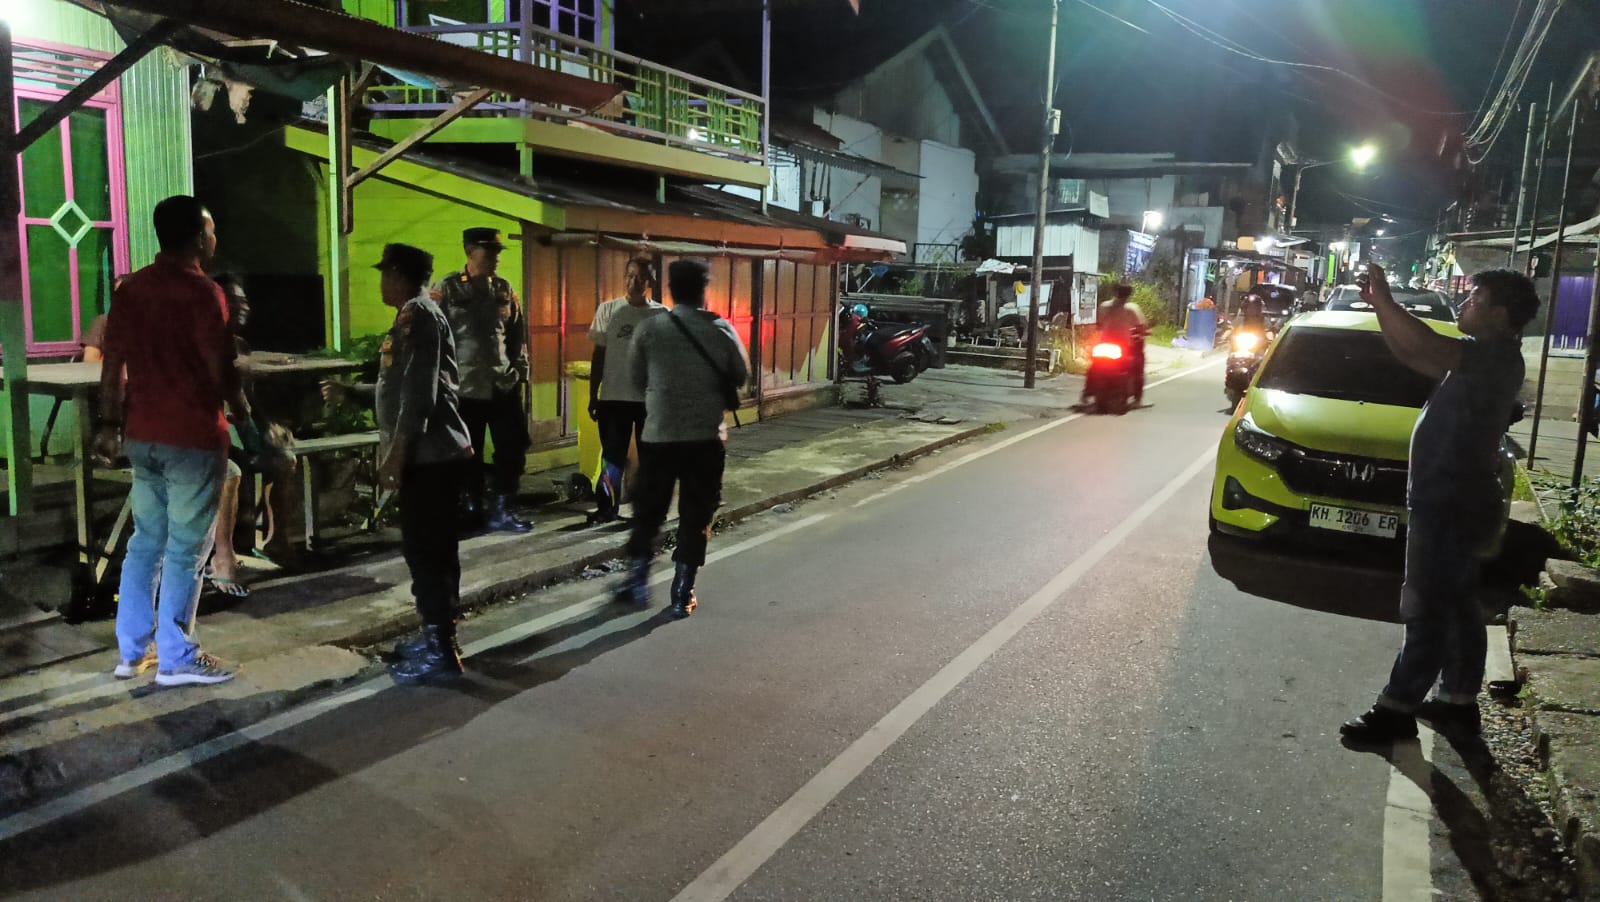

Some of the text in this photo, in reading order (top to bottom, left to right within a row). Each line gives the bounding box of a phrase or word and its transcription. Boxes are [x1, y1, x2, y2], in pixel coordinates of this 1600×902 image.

[1312, 506, 1329, 520] KH
[1336, 510, 1369, 526] 1206
[1378, 516, 1397, 530] ER
